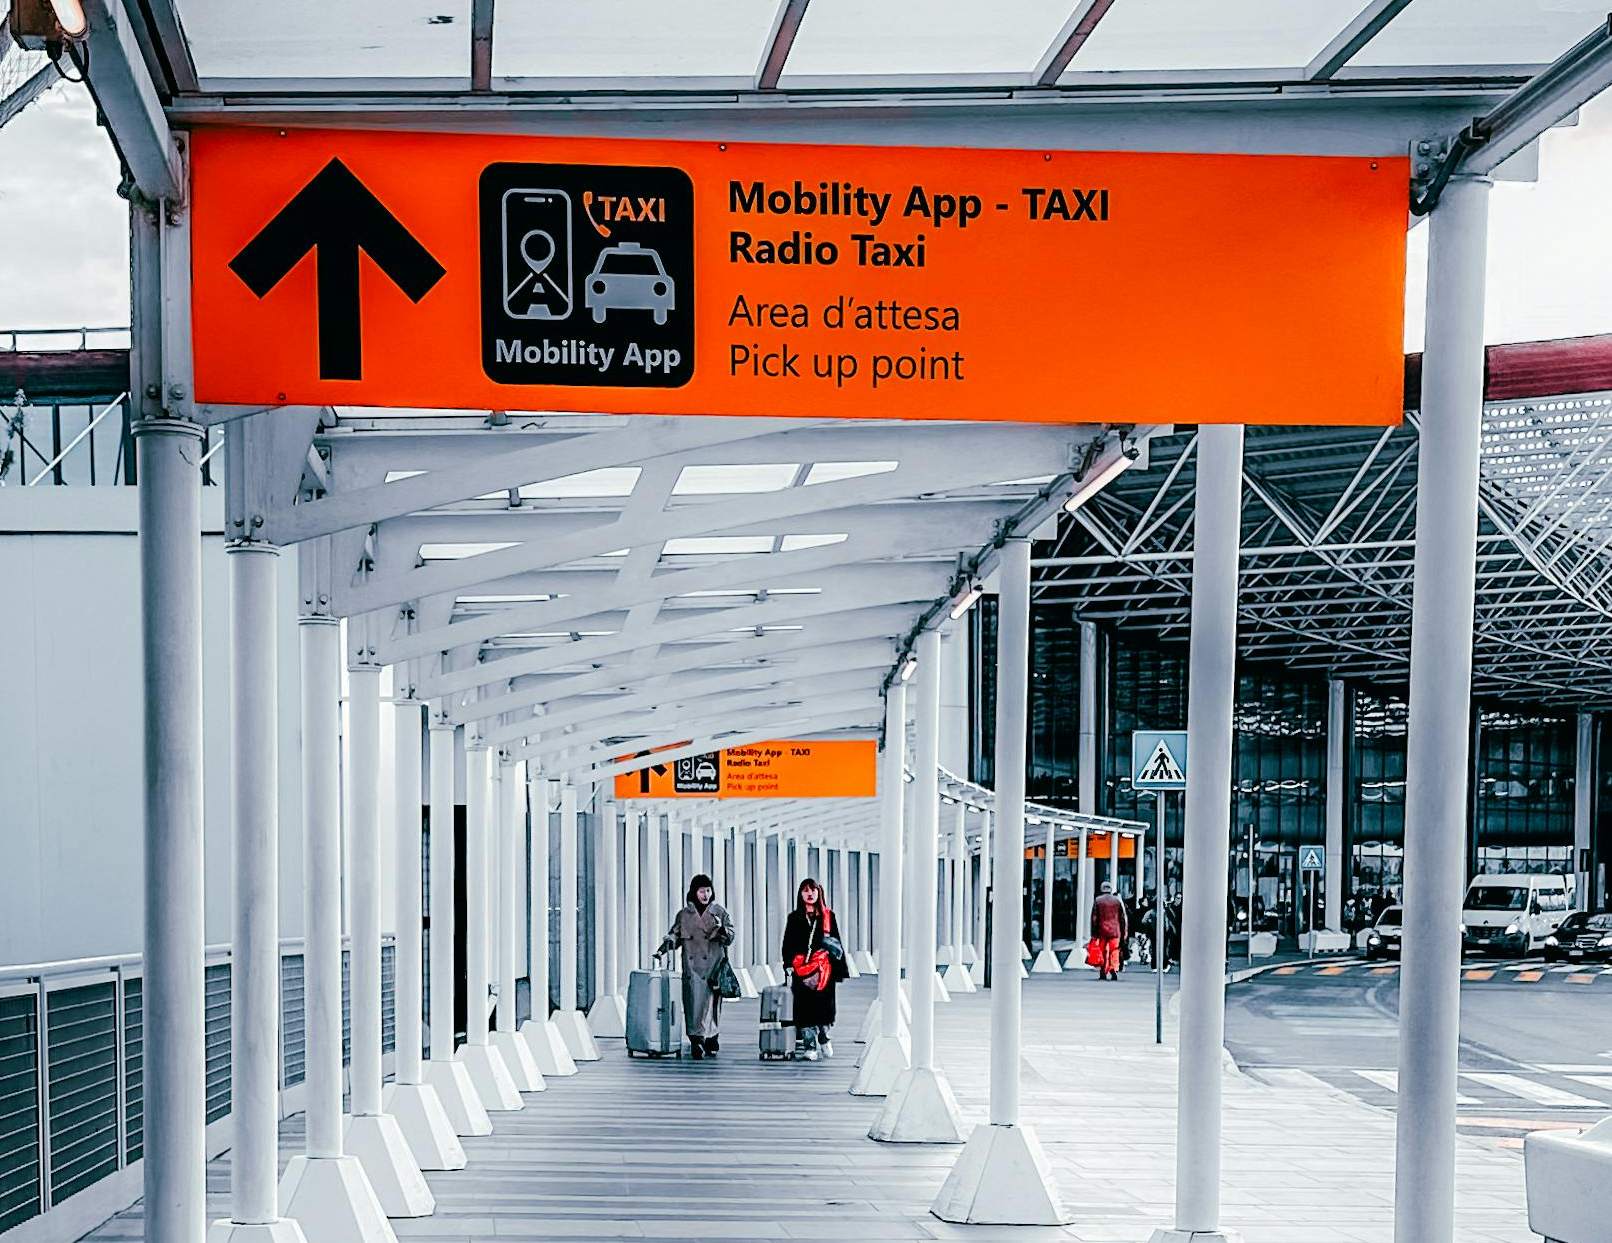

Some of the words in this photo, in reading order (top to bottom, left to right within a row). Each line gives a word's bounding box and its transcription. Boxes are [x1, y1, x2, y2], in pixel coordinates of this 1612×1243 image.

[597, 196, 666, 222] TAXI
[729, 180, 892, 226] Mobility
[903, 186, 982, 228] App
[1022, 188, 1110, 221] TAXI
[729, 231, 838, 265] Radio
[851, 234, 926, 267] Taxi
[728, 295, 809, 328] Area
[823, 296, 960, 332] d'attesa
[495, 339, 615, 372] Mobility
[622, 342, 682, 374] App
[730, 343, 800, 377] Pick
[813, 352, 858, 388] up
[873, 347, 965, 388] point
[726, 759, 751, 767] Radio
[753, 759, 770, 767] Taxi
[727, 748, 762, 757] Mobility
[765, 749, 782, 758] App
[791, 748, 810, 756] TAXI
